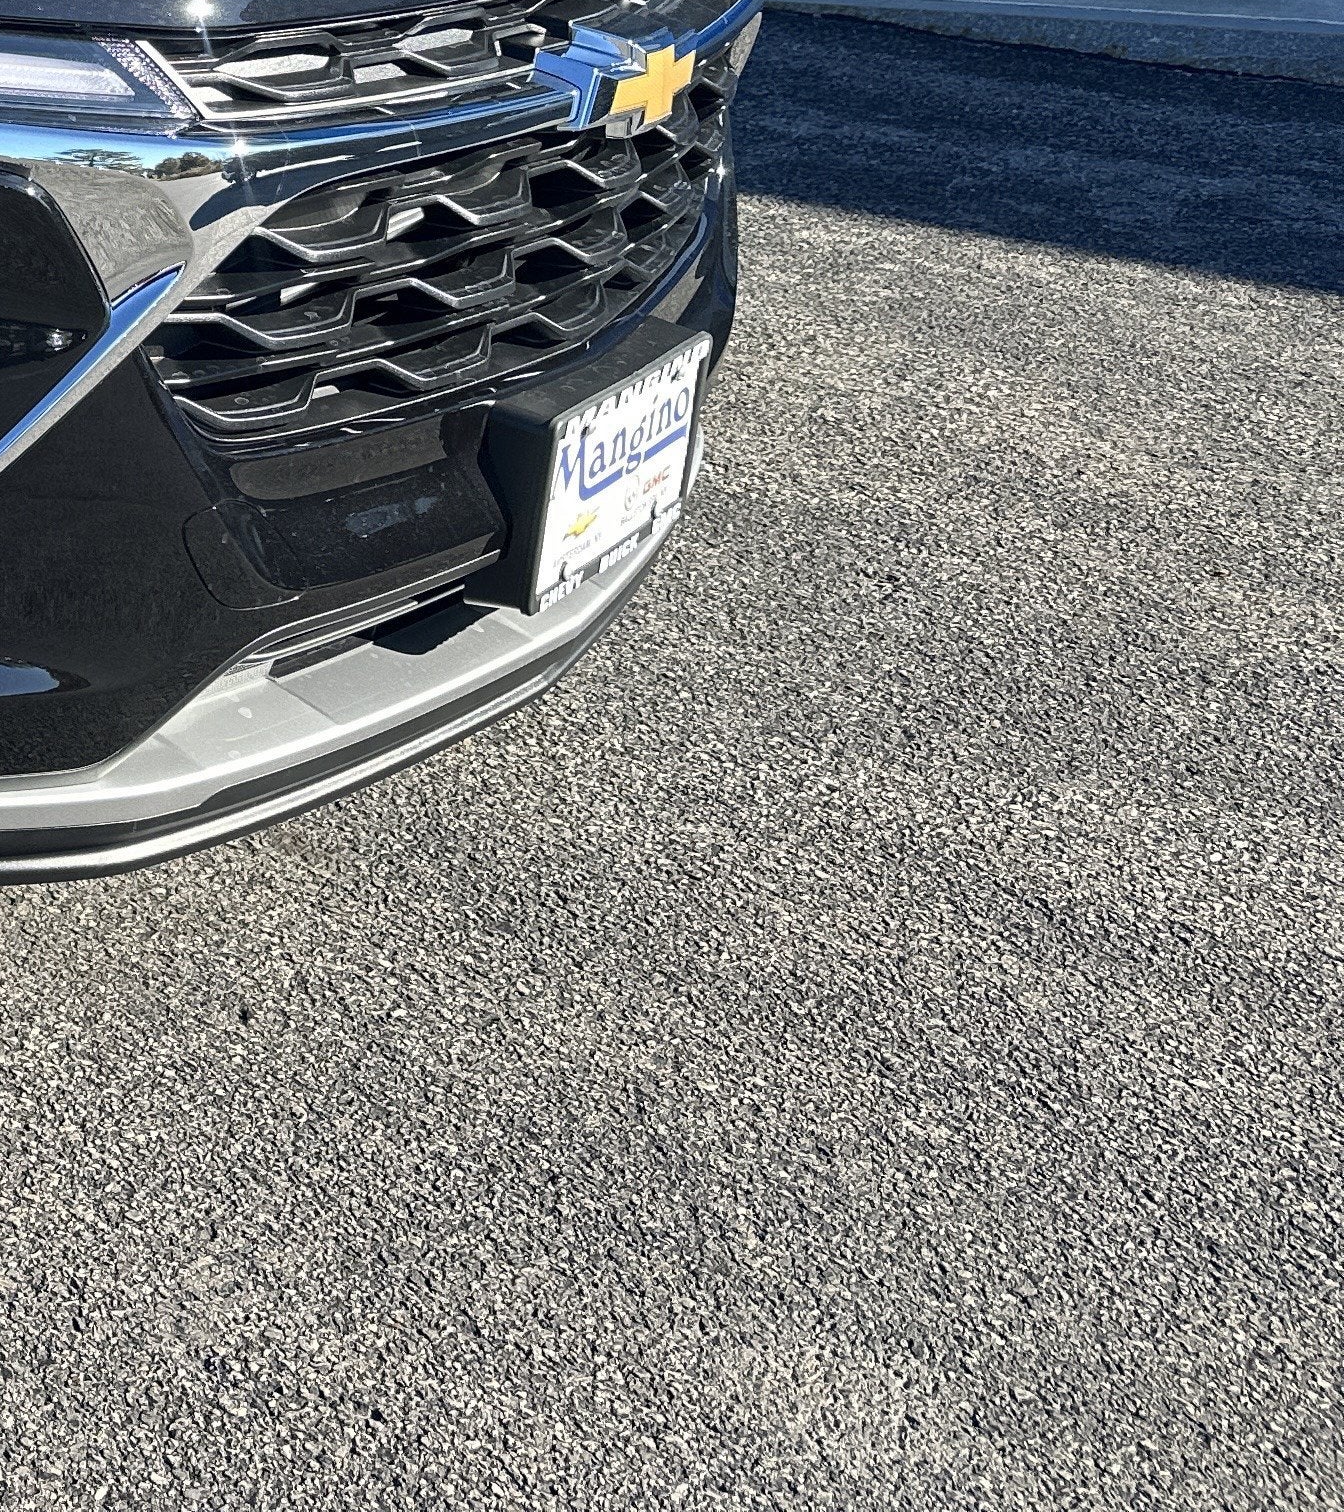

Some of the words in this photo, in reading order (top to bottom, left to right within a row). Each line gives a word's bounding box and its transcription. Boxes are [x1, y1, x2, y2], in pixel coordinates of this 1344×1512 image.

[551, 387, 690, 501] Mangino
[643, 464, 671, 495] GMC
[539, 570, 584, 612] CHEVY
[599, 533, 639, 573] BUICK
